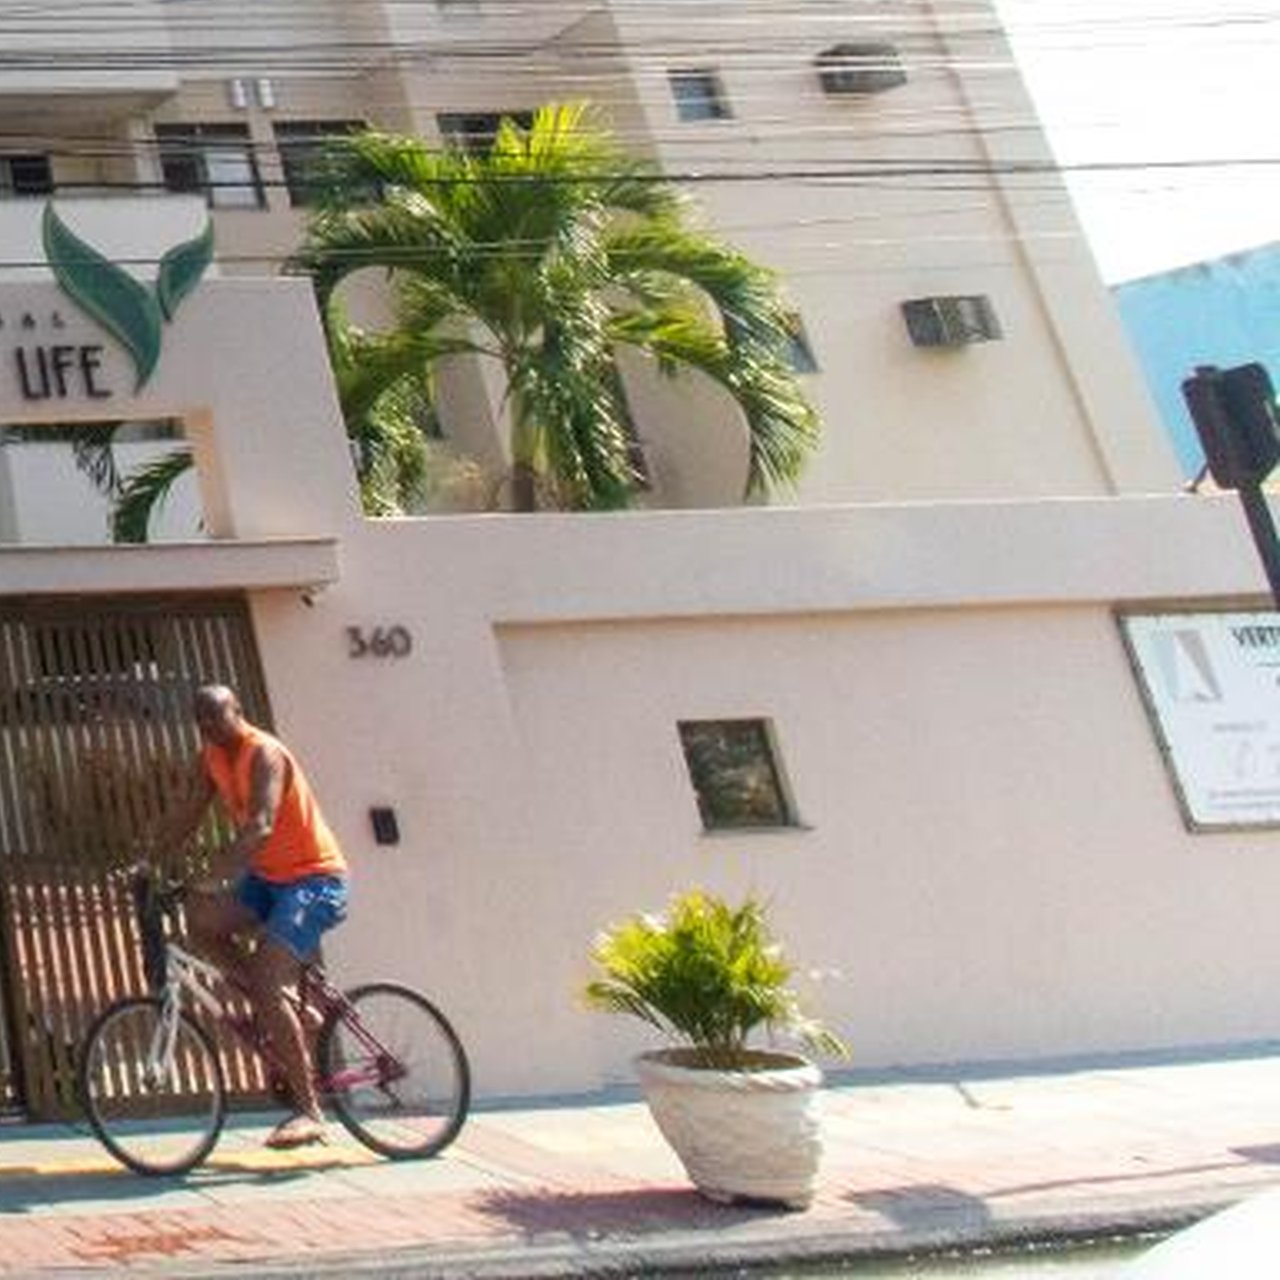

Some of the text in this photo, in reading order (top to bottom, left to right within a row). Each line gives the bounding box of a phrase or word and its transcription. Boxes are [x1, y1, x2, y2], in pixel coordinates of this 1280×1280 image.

[14, 345, 113, 401] LIFE
[345, 624, 412, 660] 360
[1229, 625, 1280, 649] VERT
